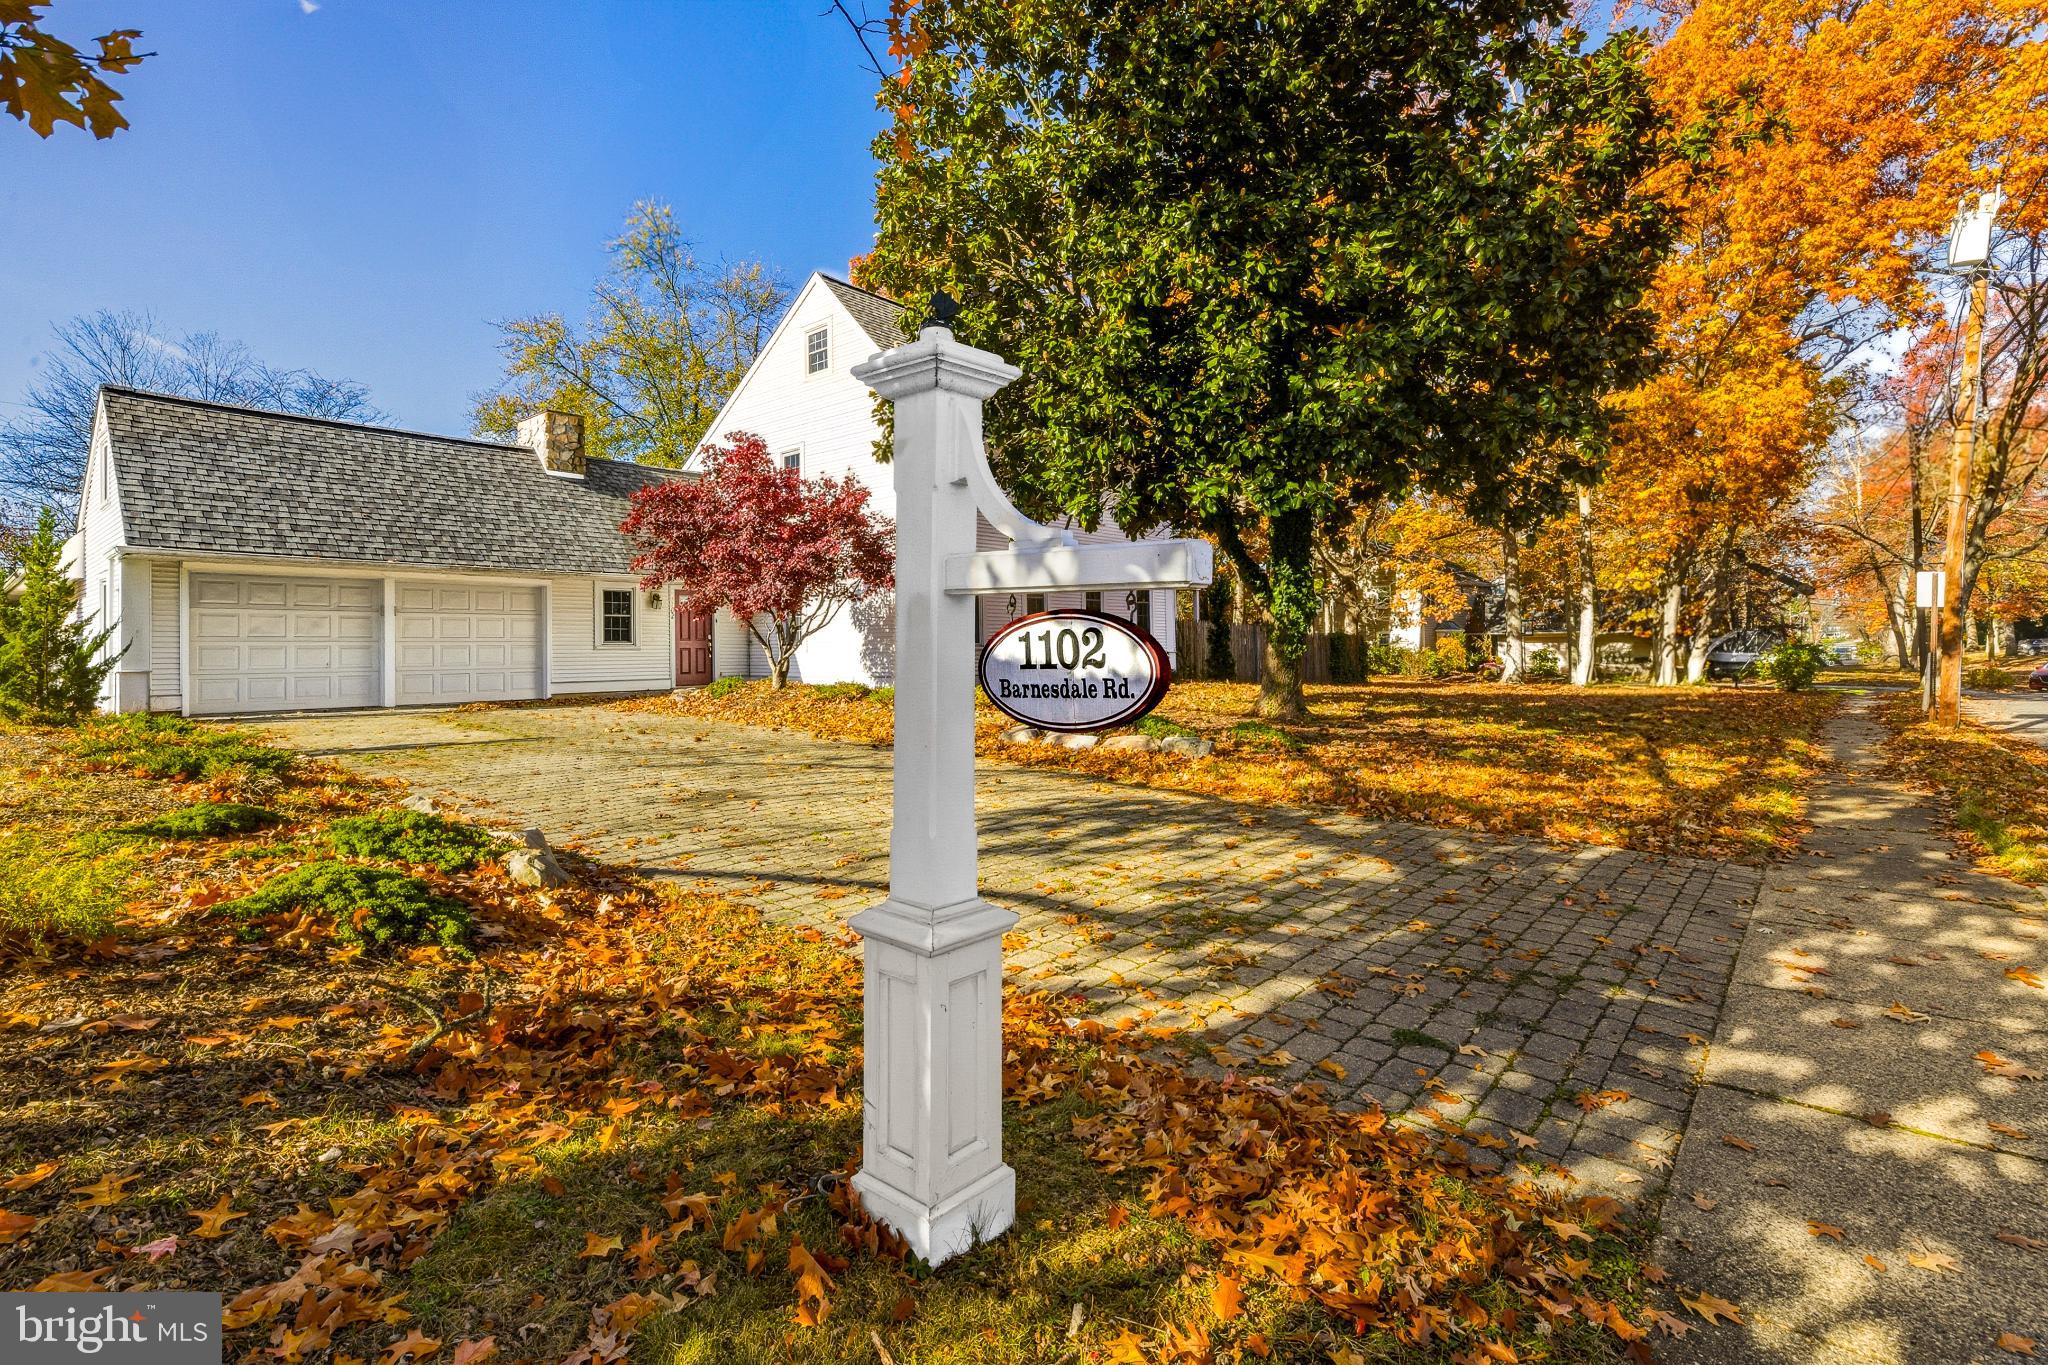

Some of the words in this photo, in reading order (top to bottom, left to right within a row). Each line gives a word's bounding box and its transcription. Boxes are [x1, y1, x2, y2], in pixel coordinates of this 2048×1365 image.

[1018, 627, 1106, 671] 1102
[999, 678, 1098, 699] Barnesdale
[1102, 678, 1135, 699] Rd.
